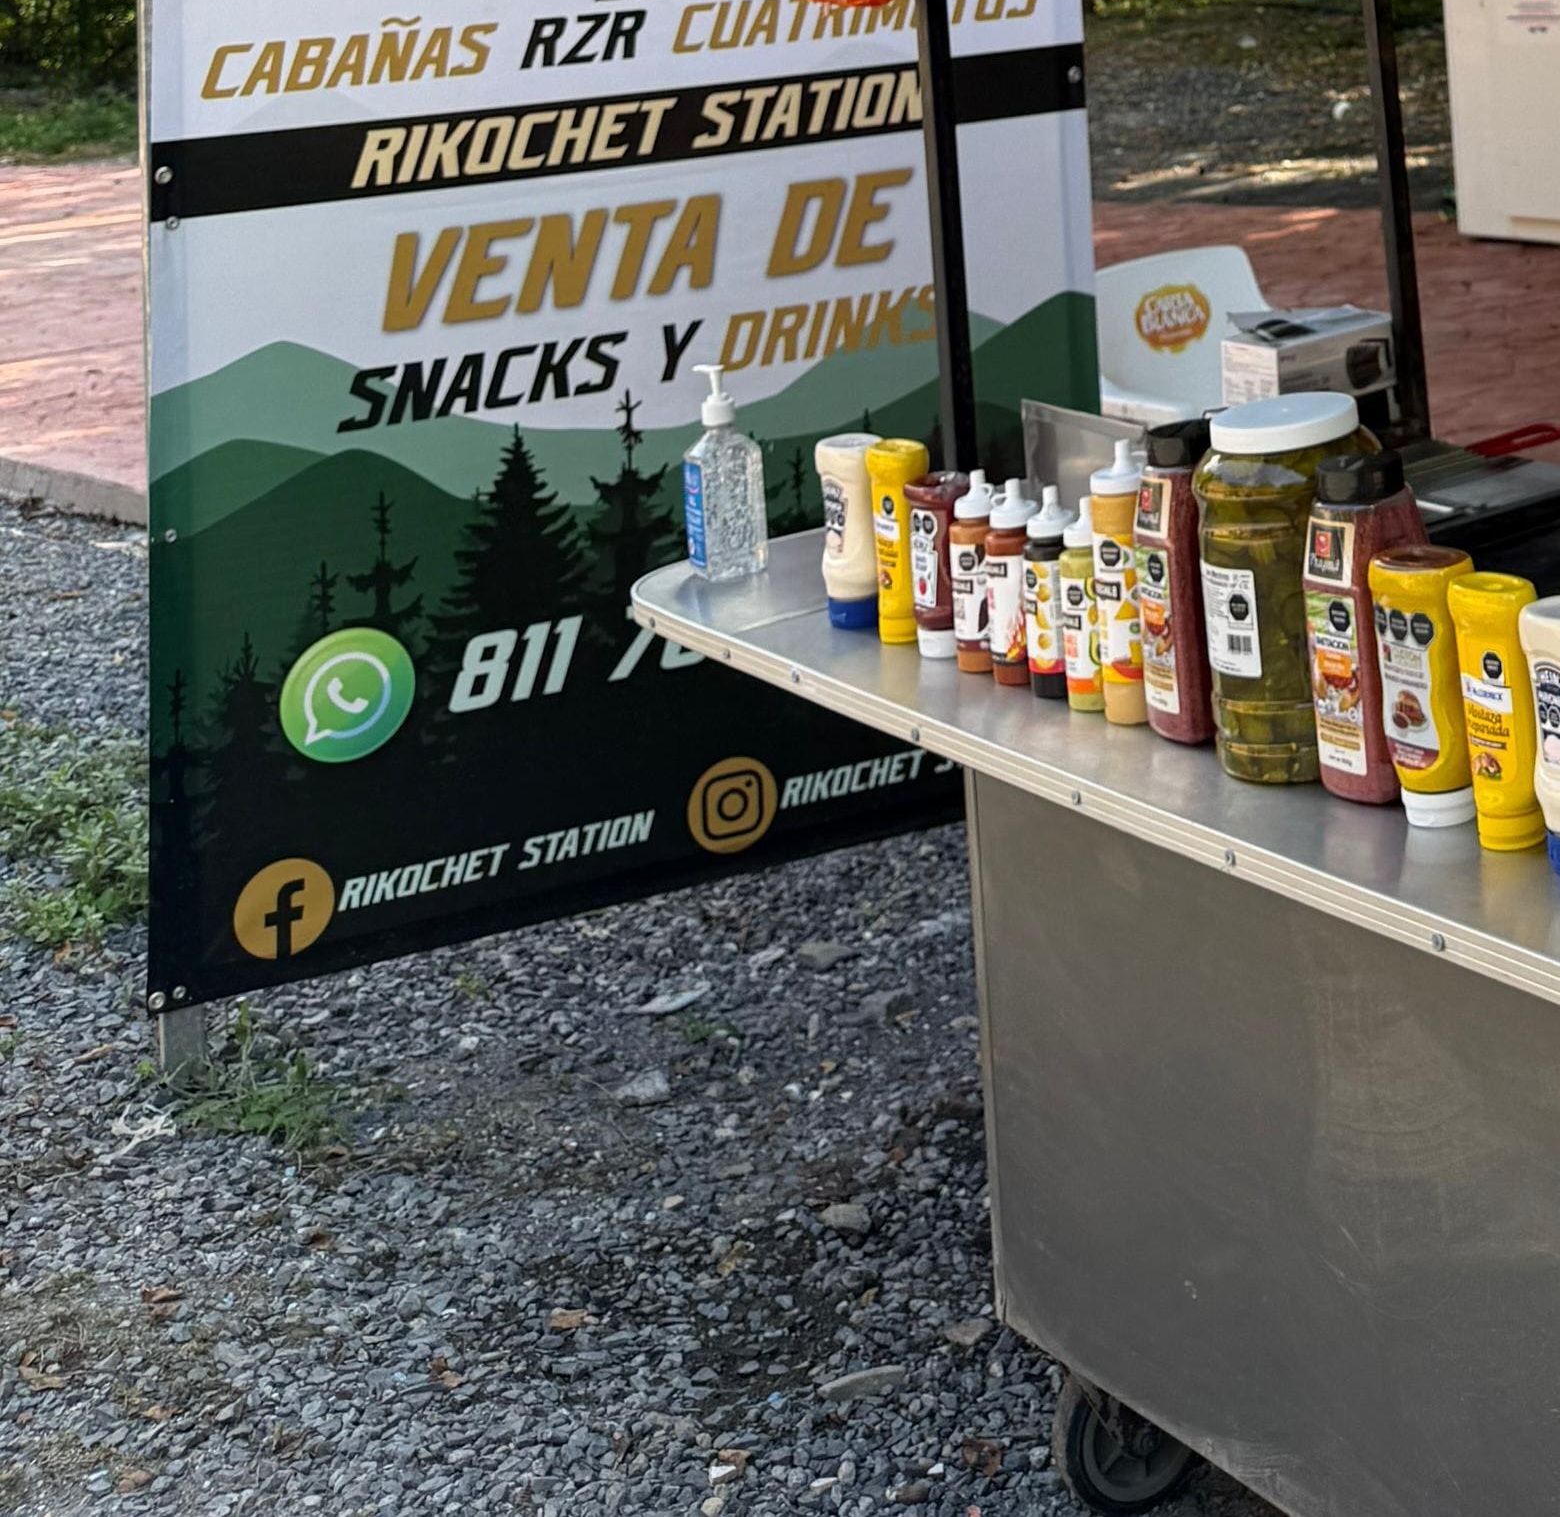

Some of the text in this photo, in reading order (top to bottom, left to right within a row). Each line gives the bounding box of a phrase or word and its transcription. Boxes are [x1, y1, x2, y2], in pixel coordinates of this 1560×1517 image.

[201, 14, 498, 100] CABAÑAS
[520, 8, 648, 70] RZR
[350, 97, 664, 190] RIKOCHET
[381, 166, 914, 334] VENTA DE
[336, 329, 627, 435] SNACKS
[660, 318, 704, 383] Y
[447, 614, 584, 714] 811
[780, 748, 927, 811] RIKOCHET
[338, 809, 656, 913] RIKOCHET STATION
